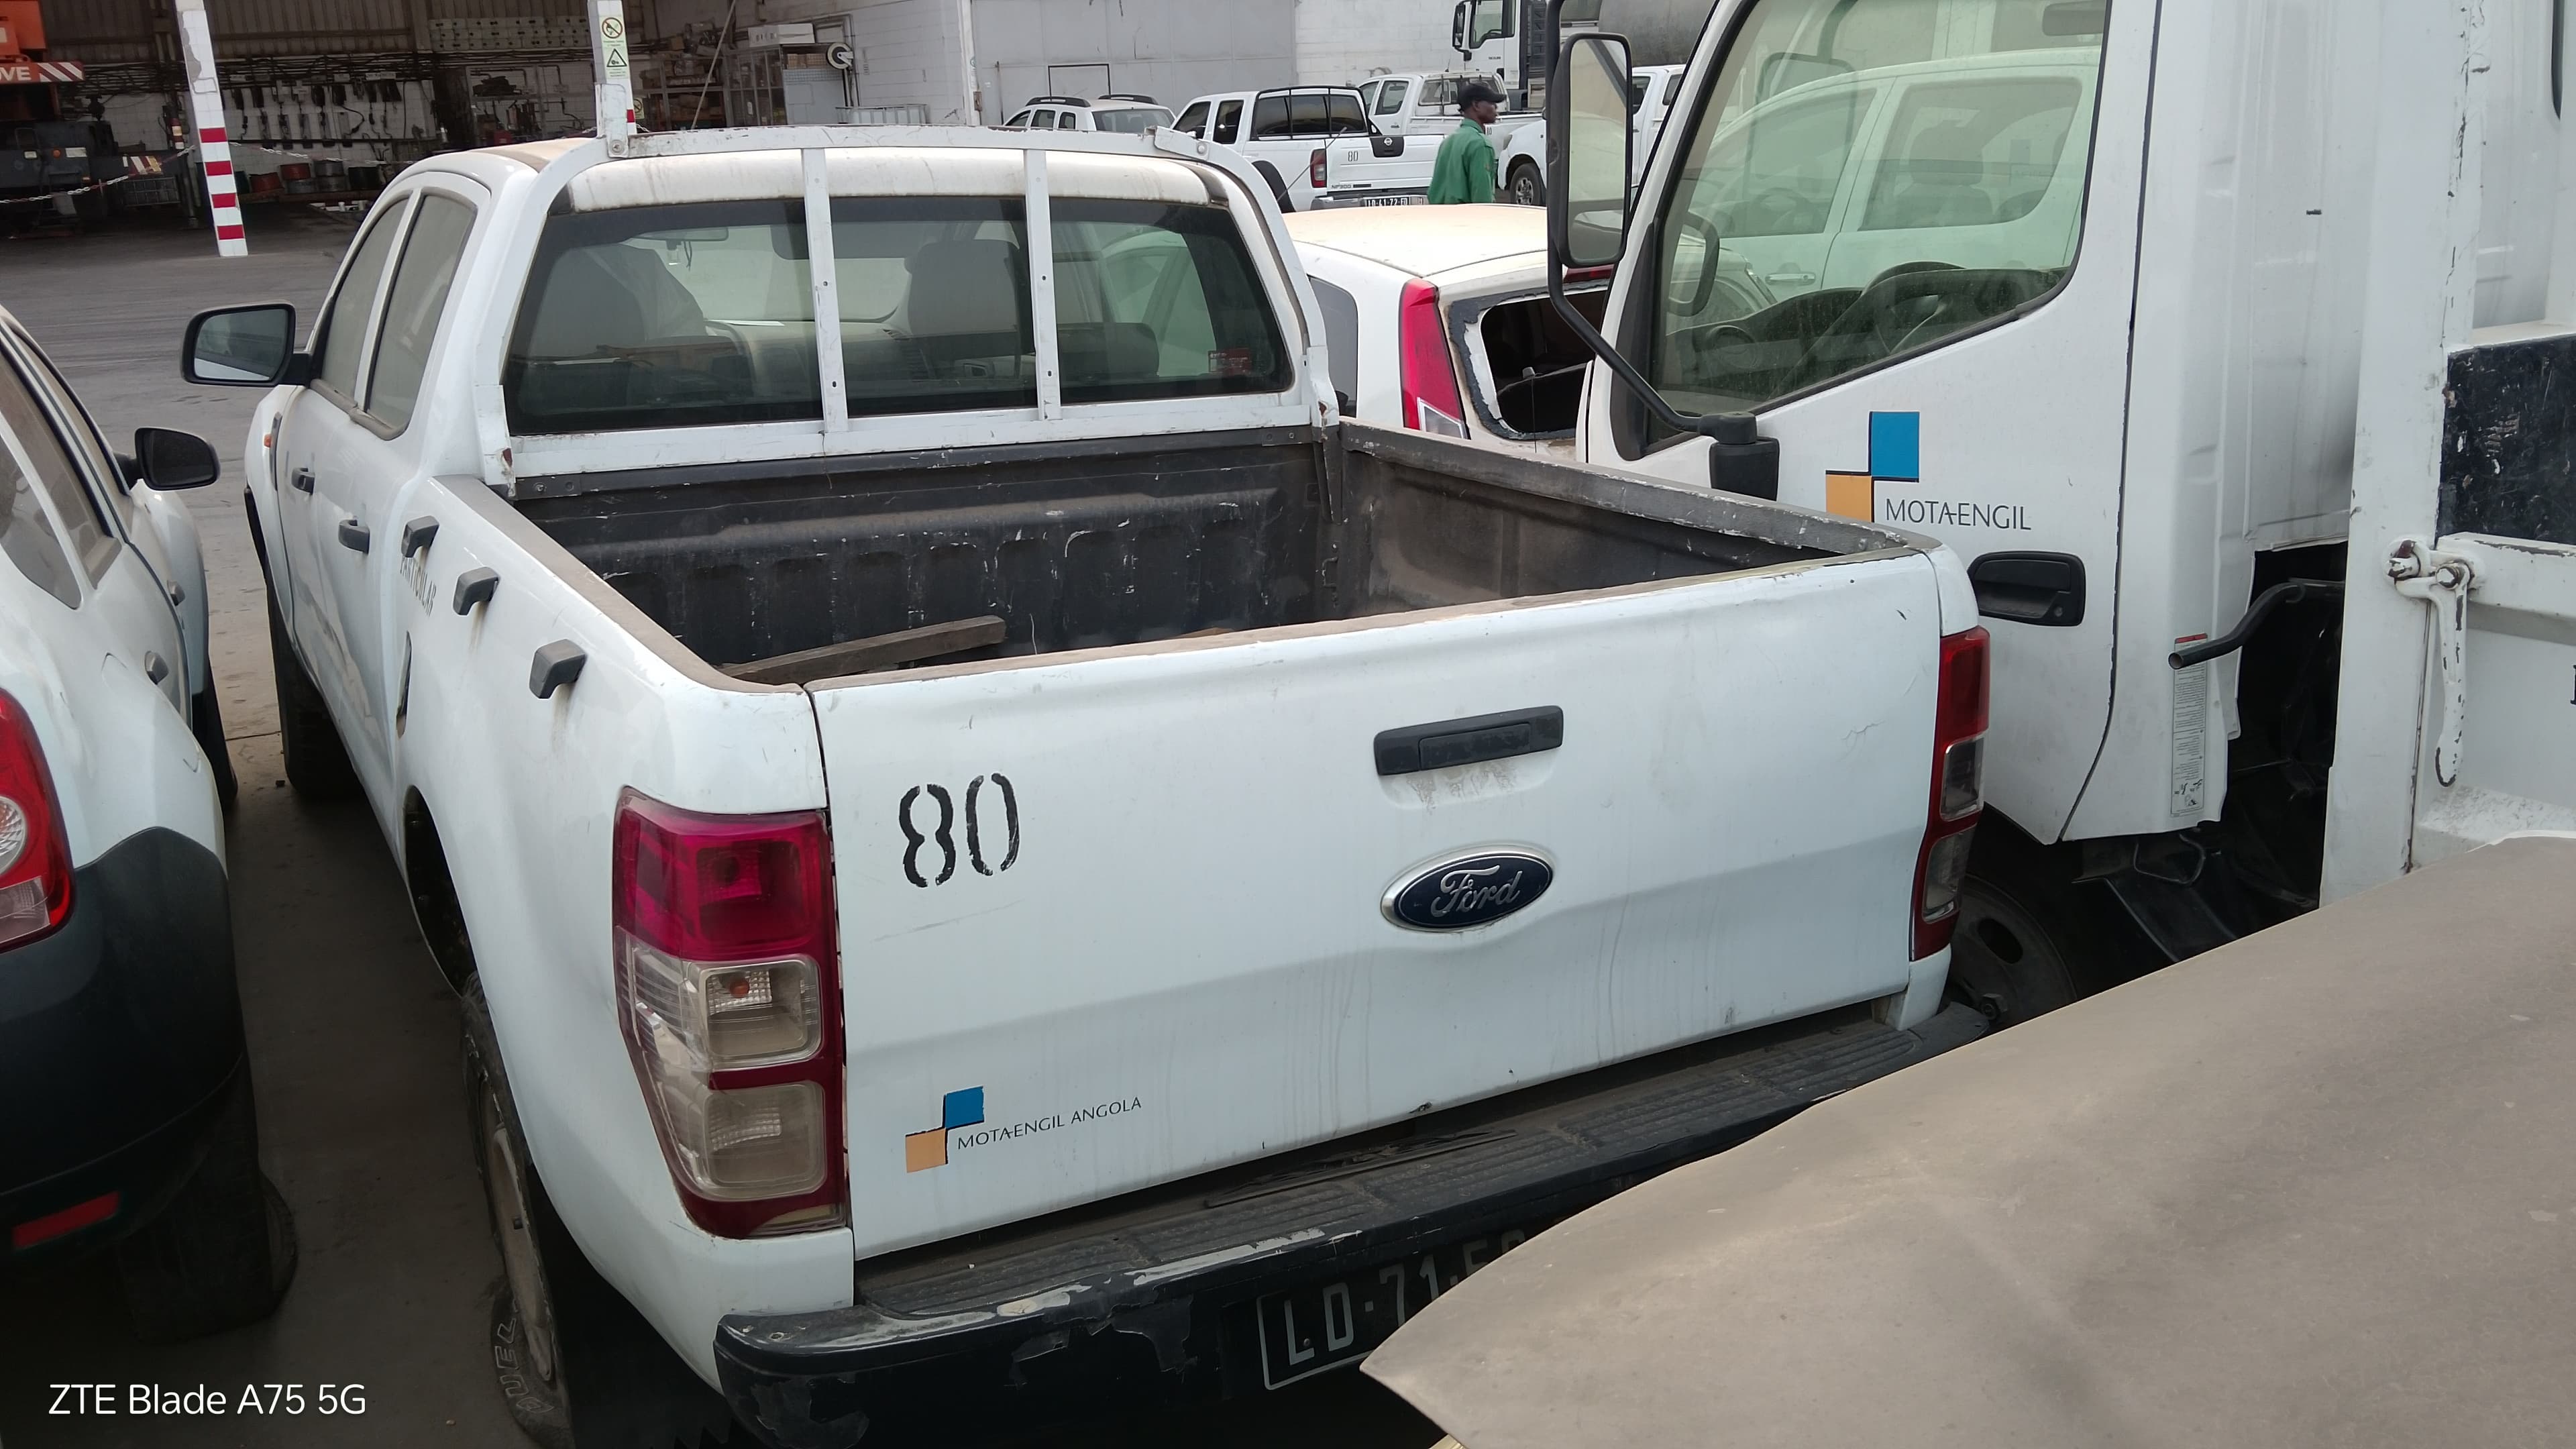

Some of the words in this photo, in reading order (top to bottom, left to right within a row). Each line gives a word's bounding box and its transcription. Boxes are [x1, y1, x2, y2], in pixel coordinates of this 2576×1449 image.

[0, 66, 32, 81] VE
[1348, 151, 1358, 162] 80
[899, 773, 1020, 888] 80
[1431, 865, 1523, 918] Ford
[1071, 1096, 1142, 1124] ANGOLA
